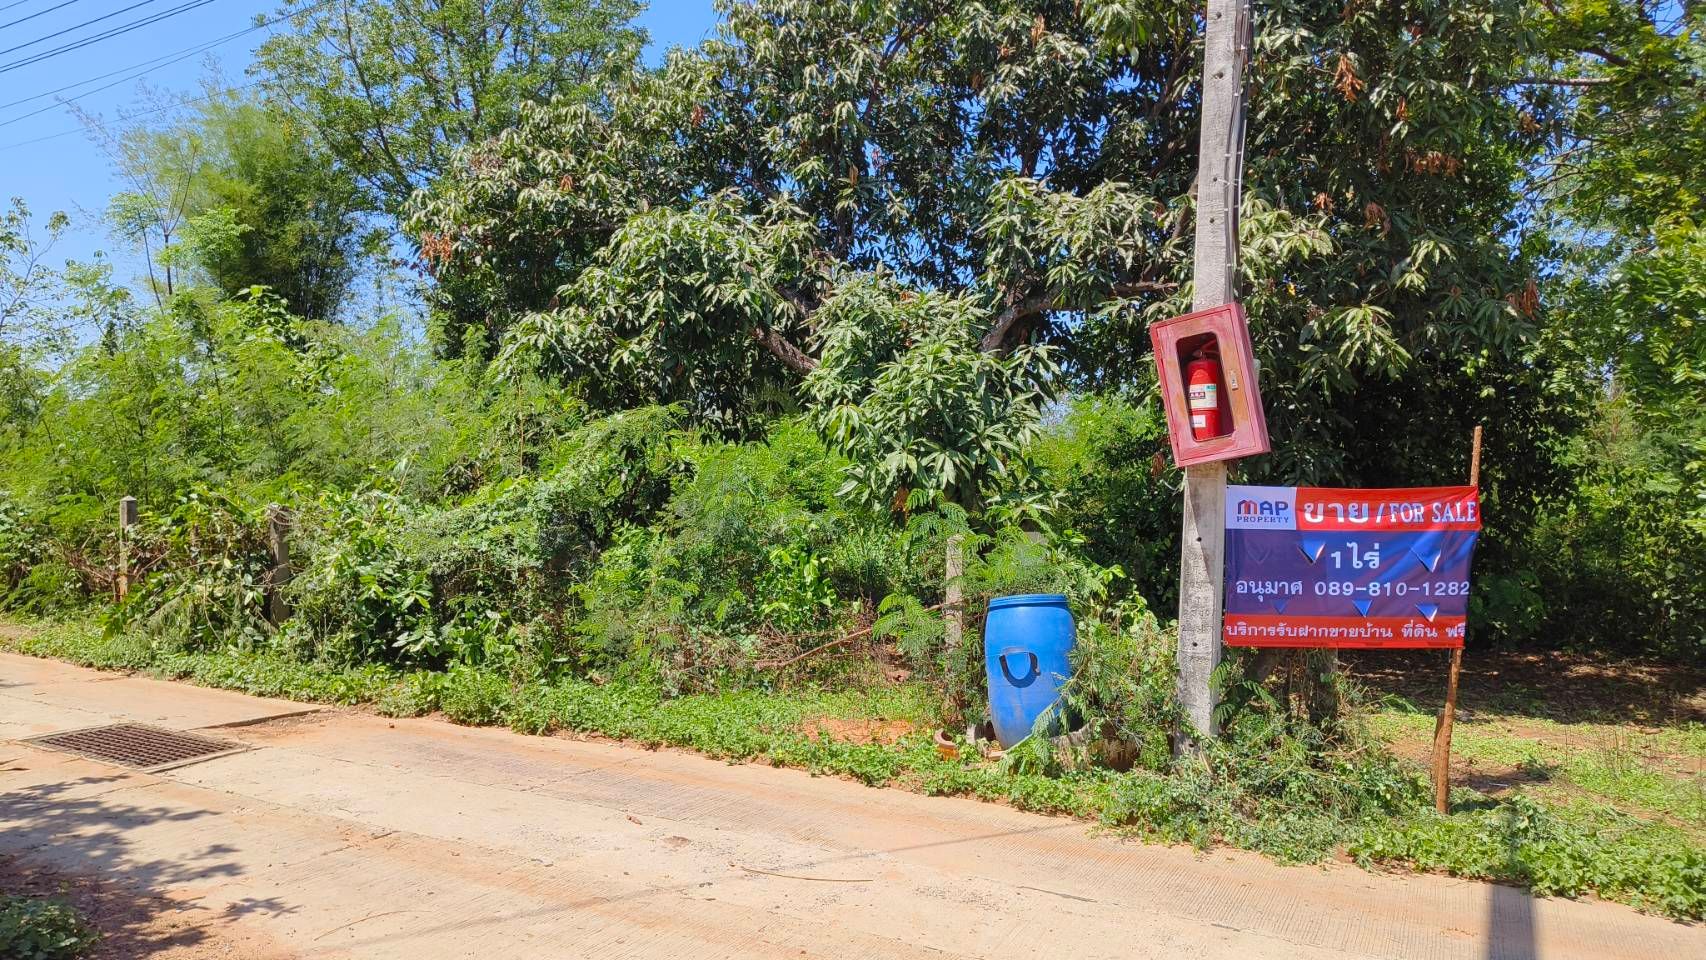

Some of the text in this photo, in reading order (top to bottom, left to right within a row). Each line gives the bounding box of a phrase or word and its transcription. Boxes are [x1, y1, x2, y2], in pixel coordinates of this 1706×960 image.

[1237, 499, 1289, 515] MAP
[1304, 502, 1369, 523] ขาย
[1432, 501, 1477, 522] SALE
[1236, 515, 1289, 523] PROPERTY
[1235, 580, 1470, 602] อนุมาศ 089-810-1282
[1225, 621, 1393, 638] บริการรับฝากขายบ้าน
[1401, 619, 1438, 638] ที่ดิน
